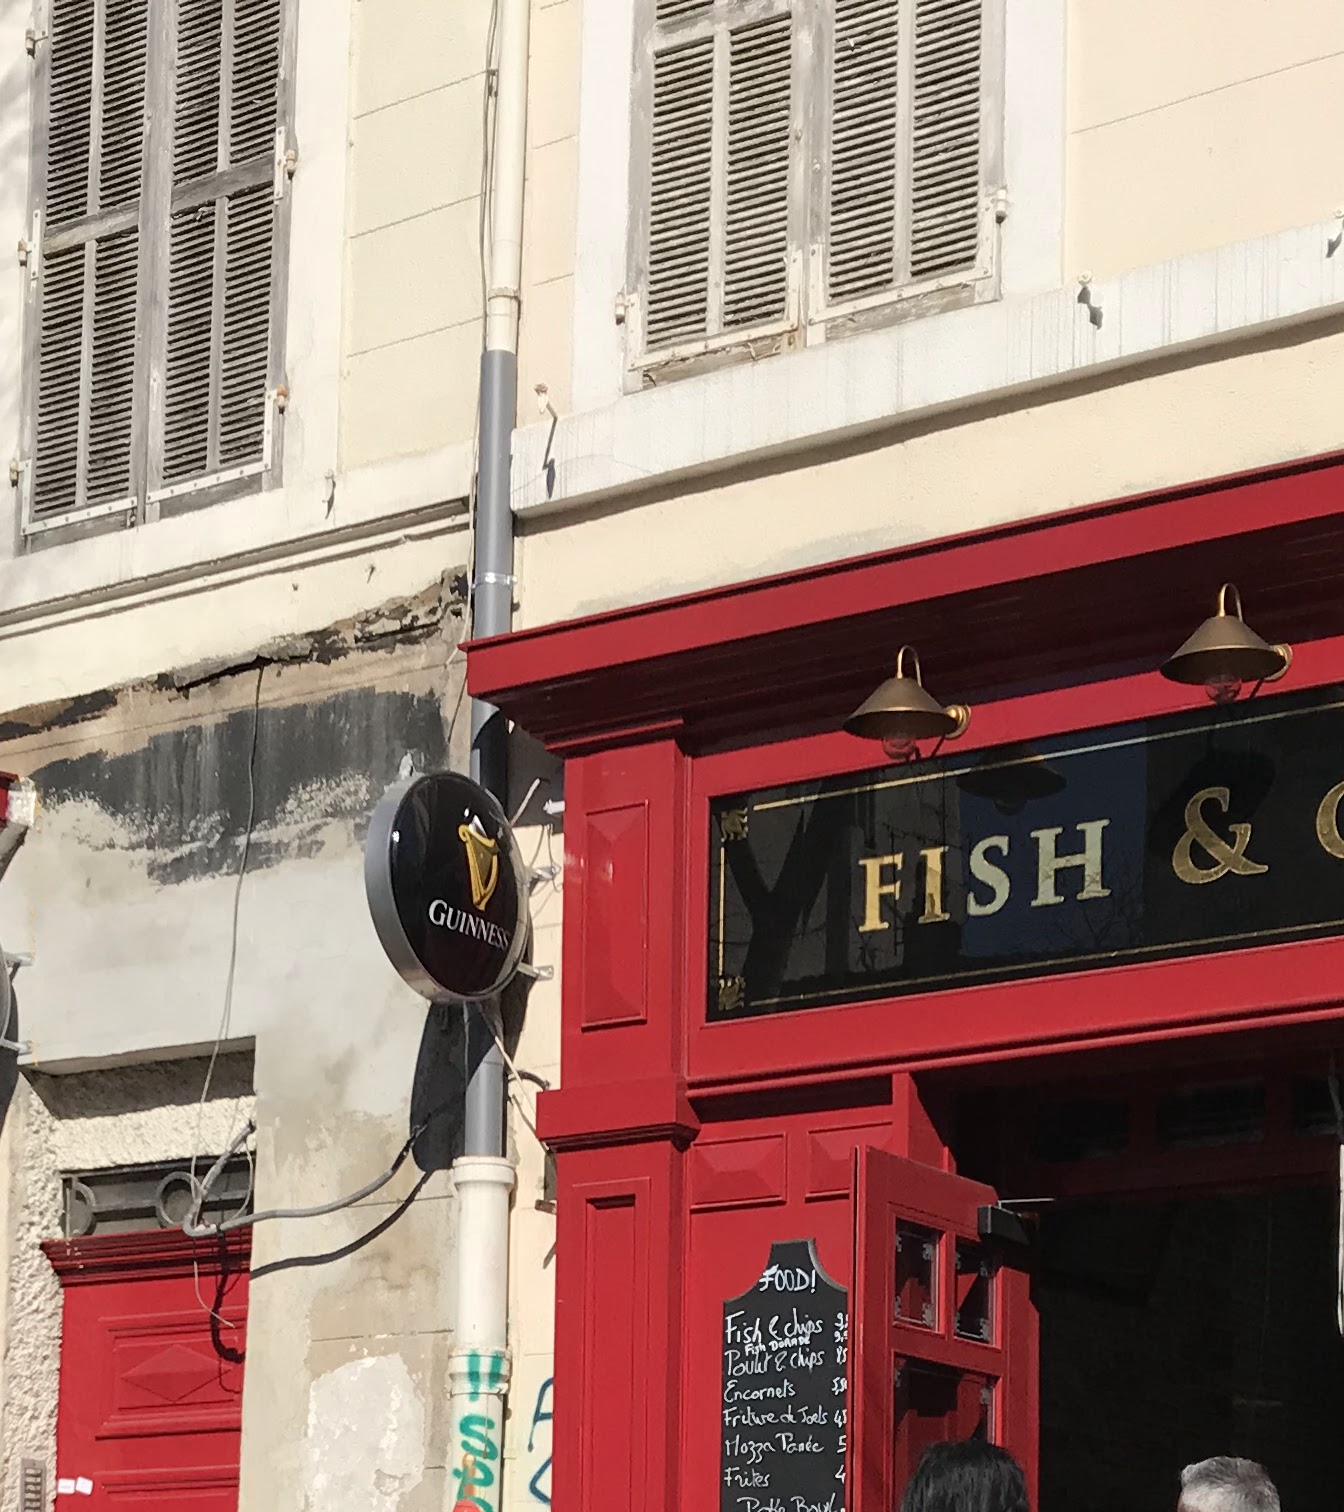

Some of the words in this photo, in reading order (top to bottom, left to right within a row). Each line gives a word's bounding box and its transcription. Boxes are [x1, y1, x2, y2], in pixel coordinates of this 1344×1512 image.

[858, 818, 1112, 934] FISH
[1172, 786, 1269, 884] &
[428, 899, 510, 950] GUINNESS
[725, 1311, 762, 1343] Fish
[723, 1379, 796, 1402] Encornets
